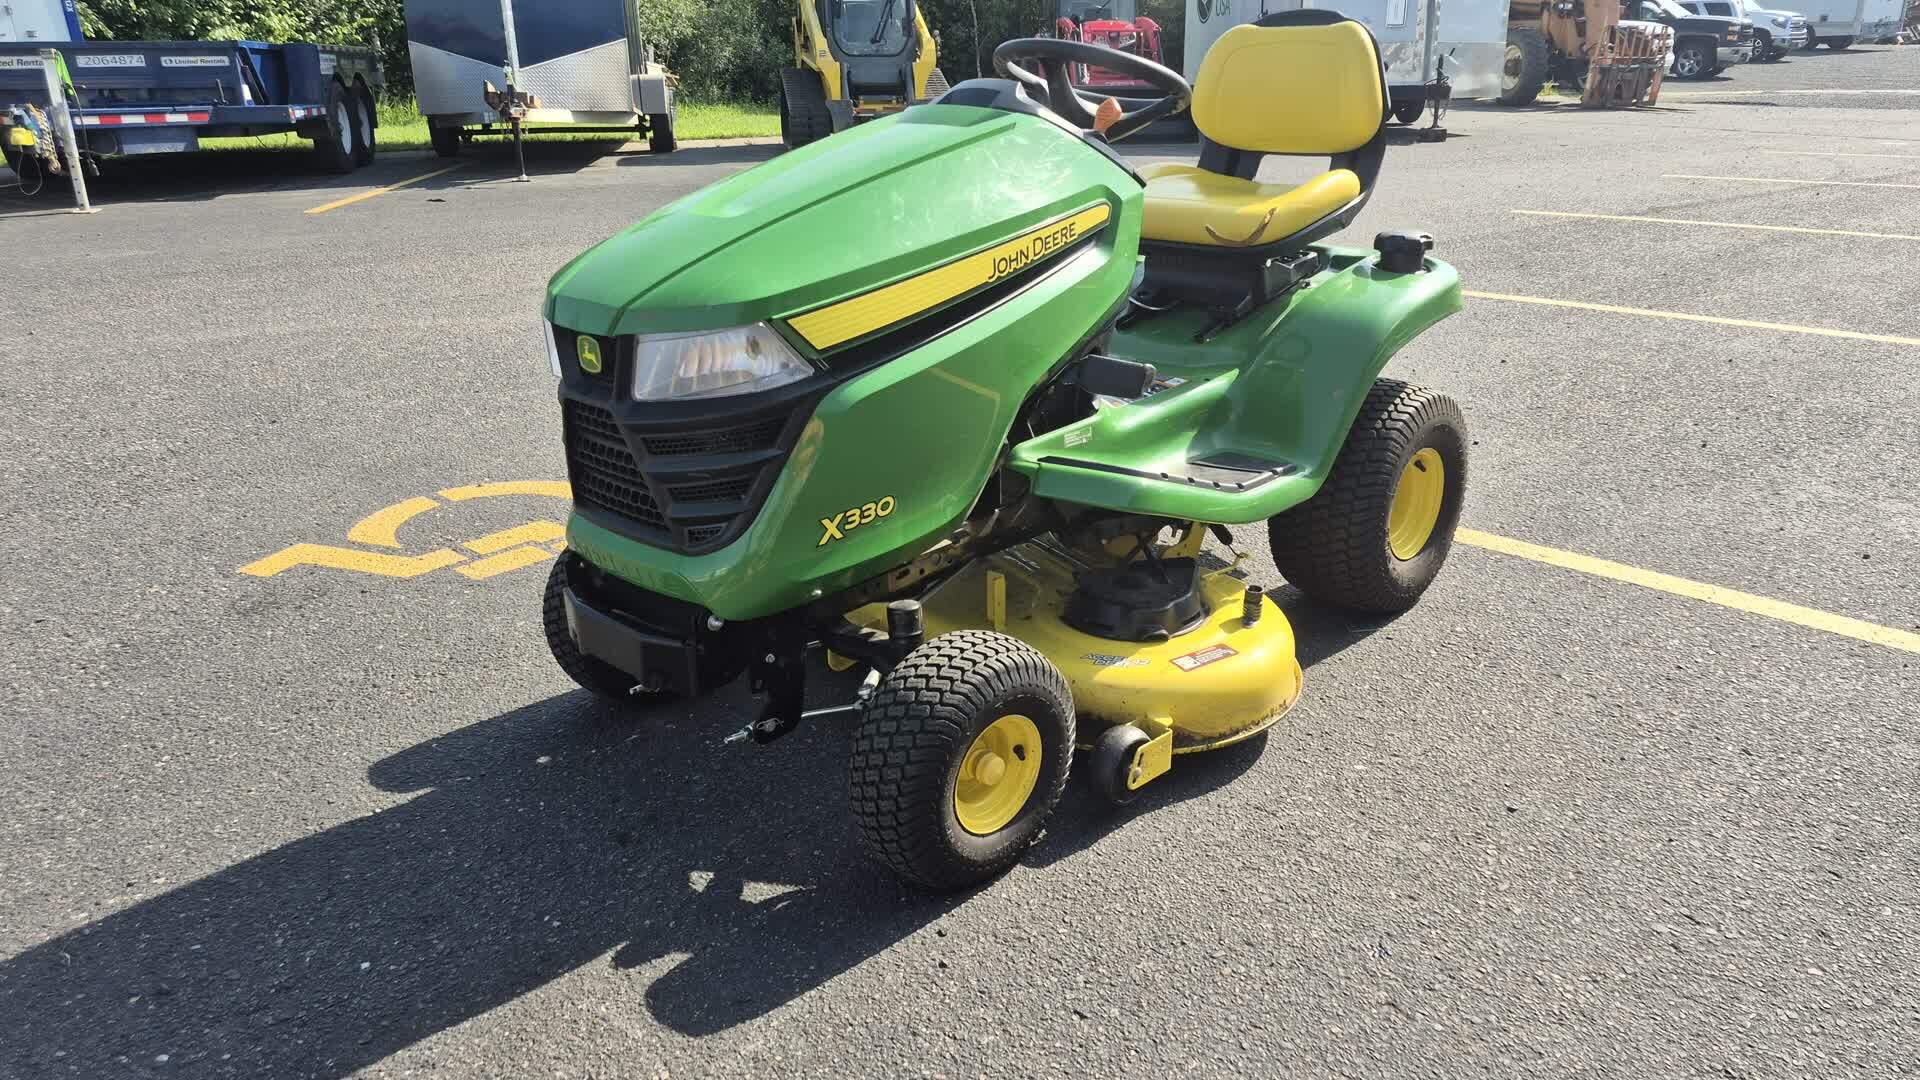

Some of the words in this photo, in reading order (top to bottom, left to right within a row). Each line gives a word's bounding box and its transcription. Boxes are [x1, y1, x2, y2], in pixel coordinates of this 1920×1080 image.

[1215, 0, 1231, 17] USA
[84, 55, 145, 66] 2064874
[987, 245, 1030, 281] JOHN
[1032, 221, 1077, 258] DEERE
[816, 494, 896, 548] X330
